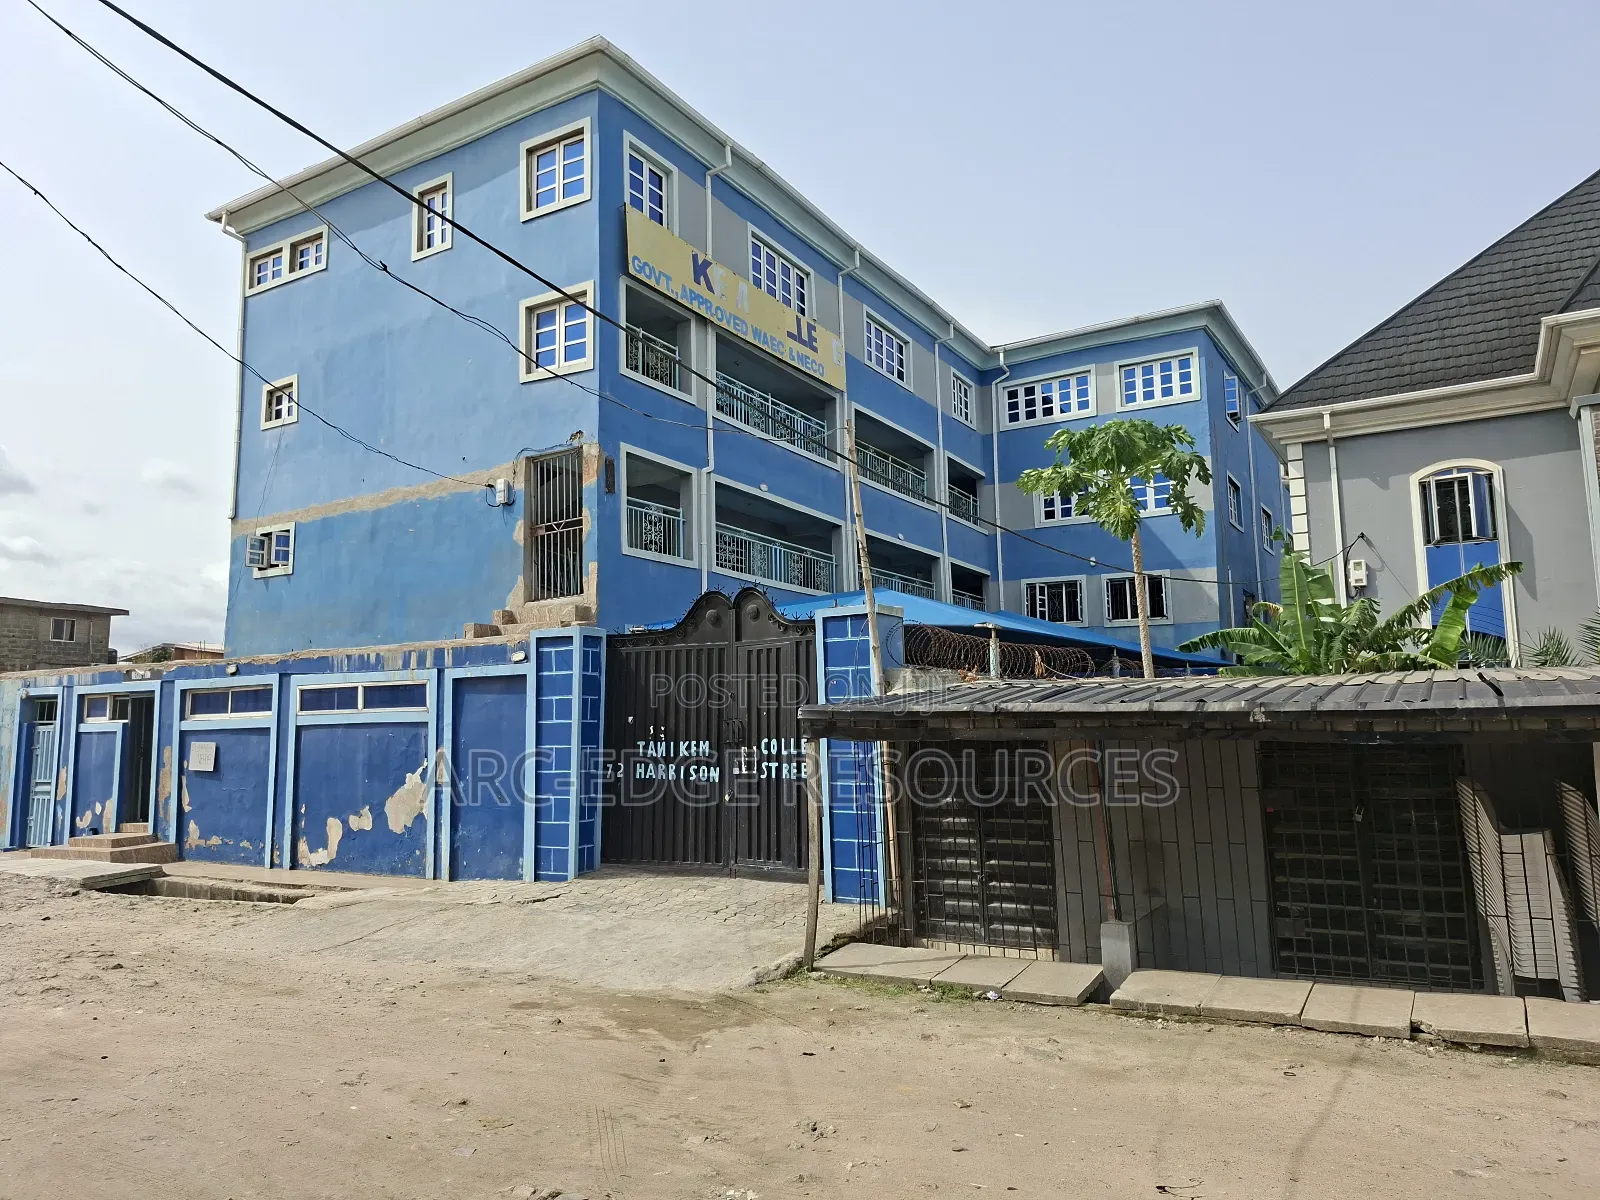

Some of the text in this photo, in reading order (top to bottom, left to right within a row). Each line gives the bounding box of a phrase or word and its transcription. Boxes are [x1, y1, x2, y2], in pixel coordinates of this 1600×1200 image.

[681, 283, 749, 337] APPROVED
[751, 324, 785, 356] WAEC
[788, 346, 796, 362] &
[796, 350, 825, 378] NECO
[761, 738, 807, 756] COLLE
[635, 763, 720, 783] HARRISON
[760, 761, 807, 779] STREE
